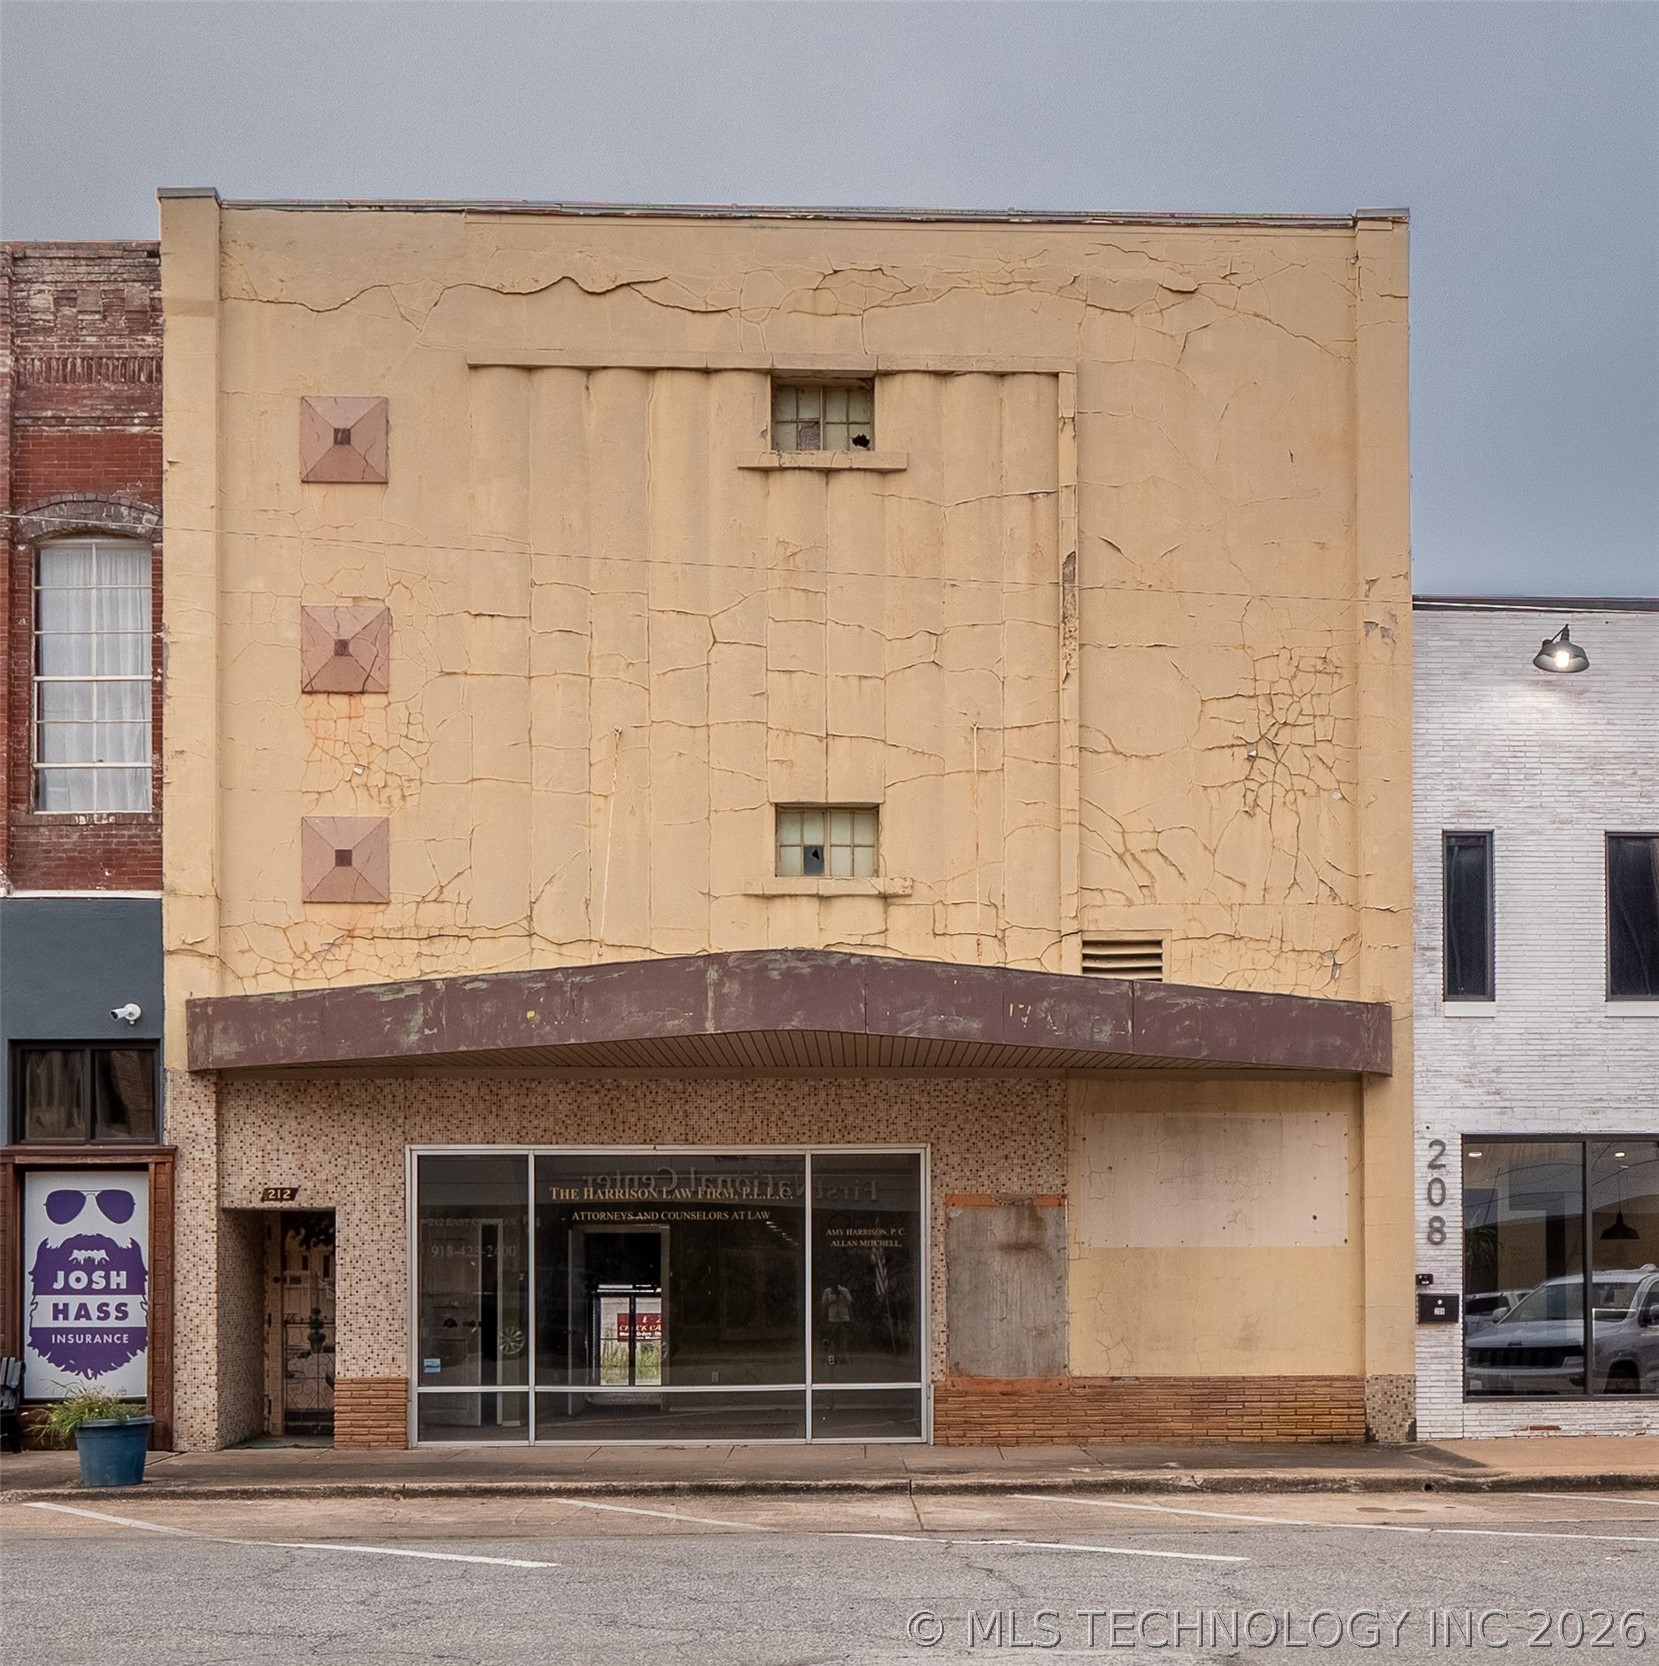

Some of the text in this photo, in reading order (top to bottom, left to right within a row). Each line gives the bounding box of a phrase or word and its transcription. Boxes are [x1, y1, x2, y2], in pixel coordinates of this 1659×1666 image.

[267, 1189, 292, 1199] 212
[549, 1186, 580, 1200] THE
[583, 1186, 658, 1200] HARRISON
[662, 1186, 693, 1200] LAW
[1427, 1138, 1447, 1246] 208
[571, 1211, 771, 1221] ATTORNEYS AND COUNSELORS AT LAW
[826, 1228, 845, 1236] AMY
[831, 1239, 858, 1248] ALLAN
[52, 1269, 127, 1290] JOSH
[52, 1302, 130, 1321] HASS
[51, 1333, 130, 1344] INSURANCE
